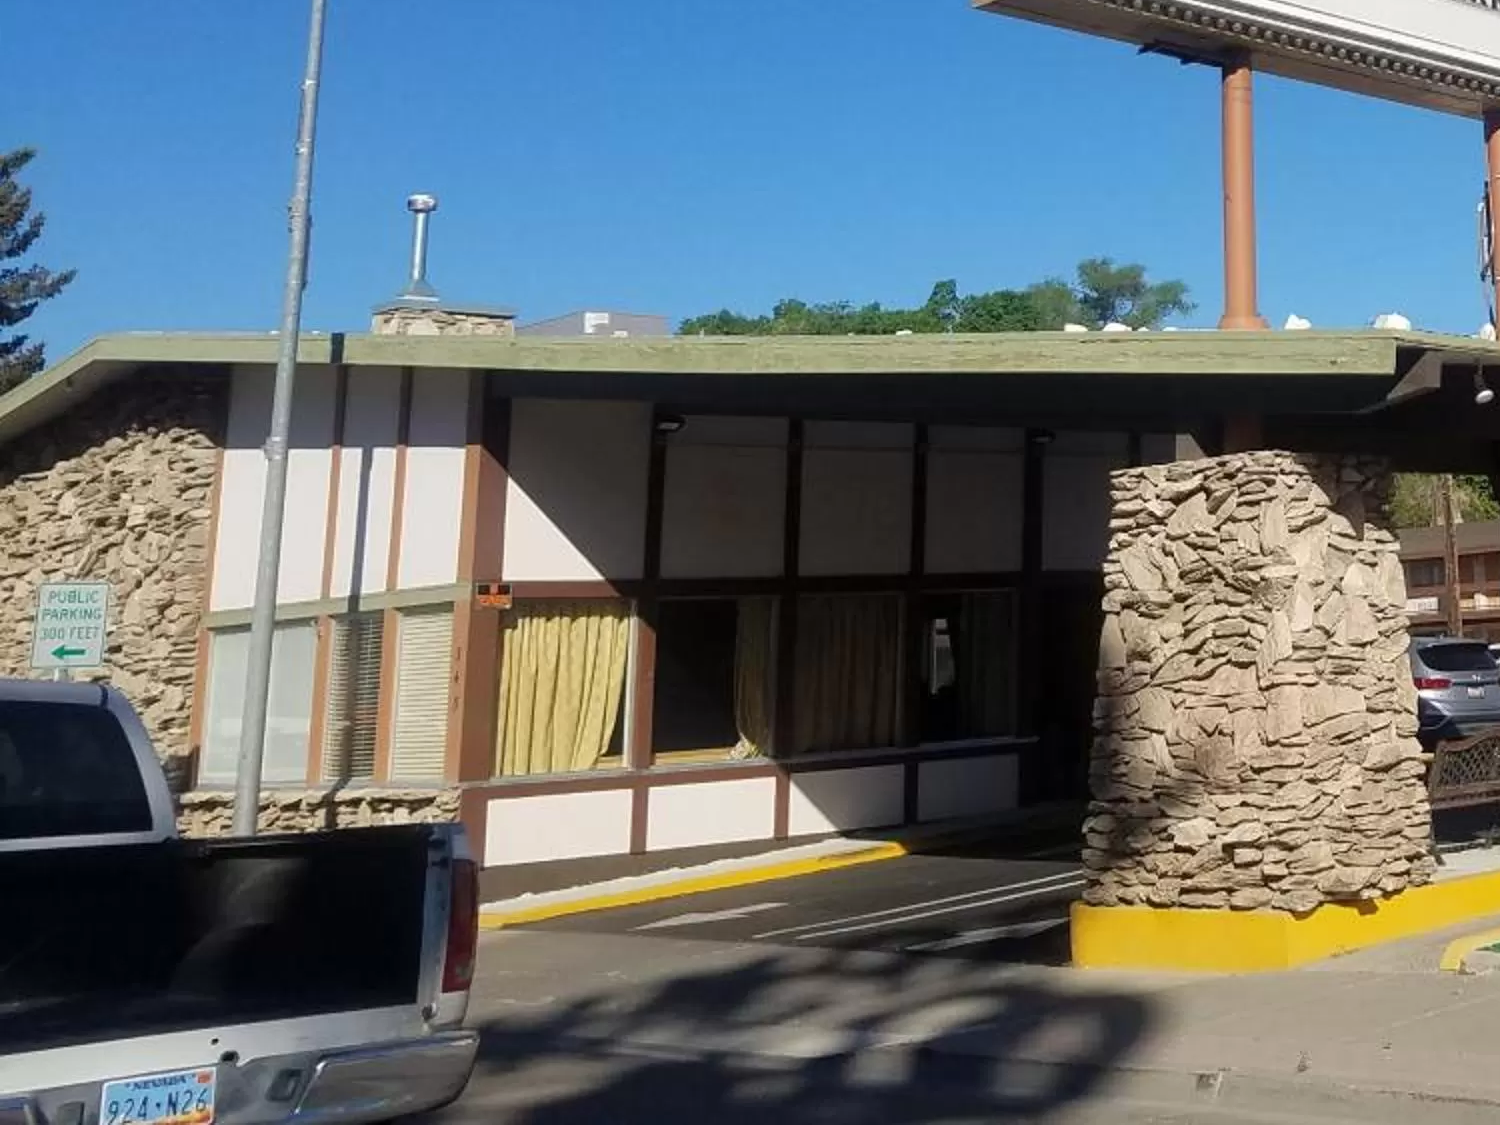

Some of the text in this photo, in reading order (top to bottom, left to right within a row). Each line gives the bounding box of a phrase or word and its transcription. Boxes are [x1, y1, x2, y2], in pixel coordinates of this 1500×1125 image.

[48, 590, 99, 604] PUBLIC
[42, 608, 102, 621] PARKING
[69, 626, 99, 640] FEET
